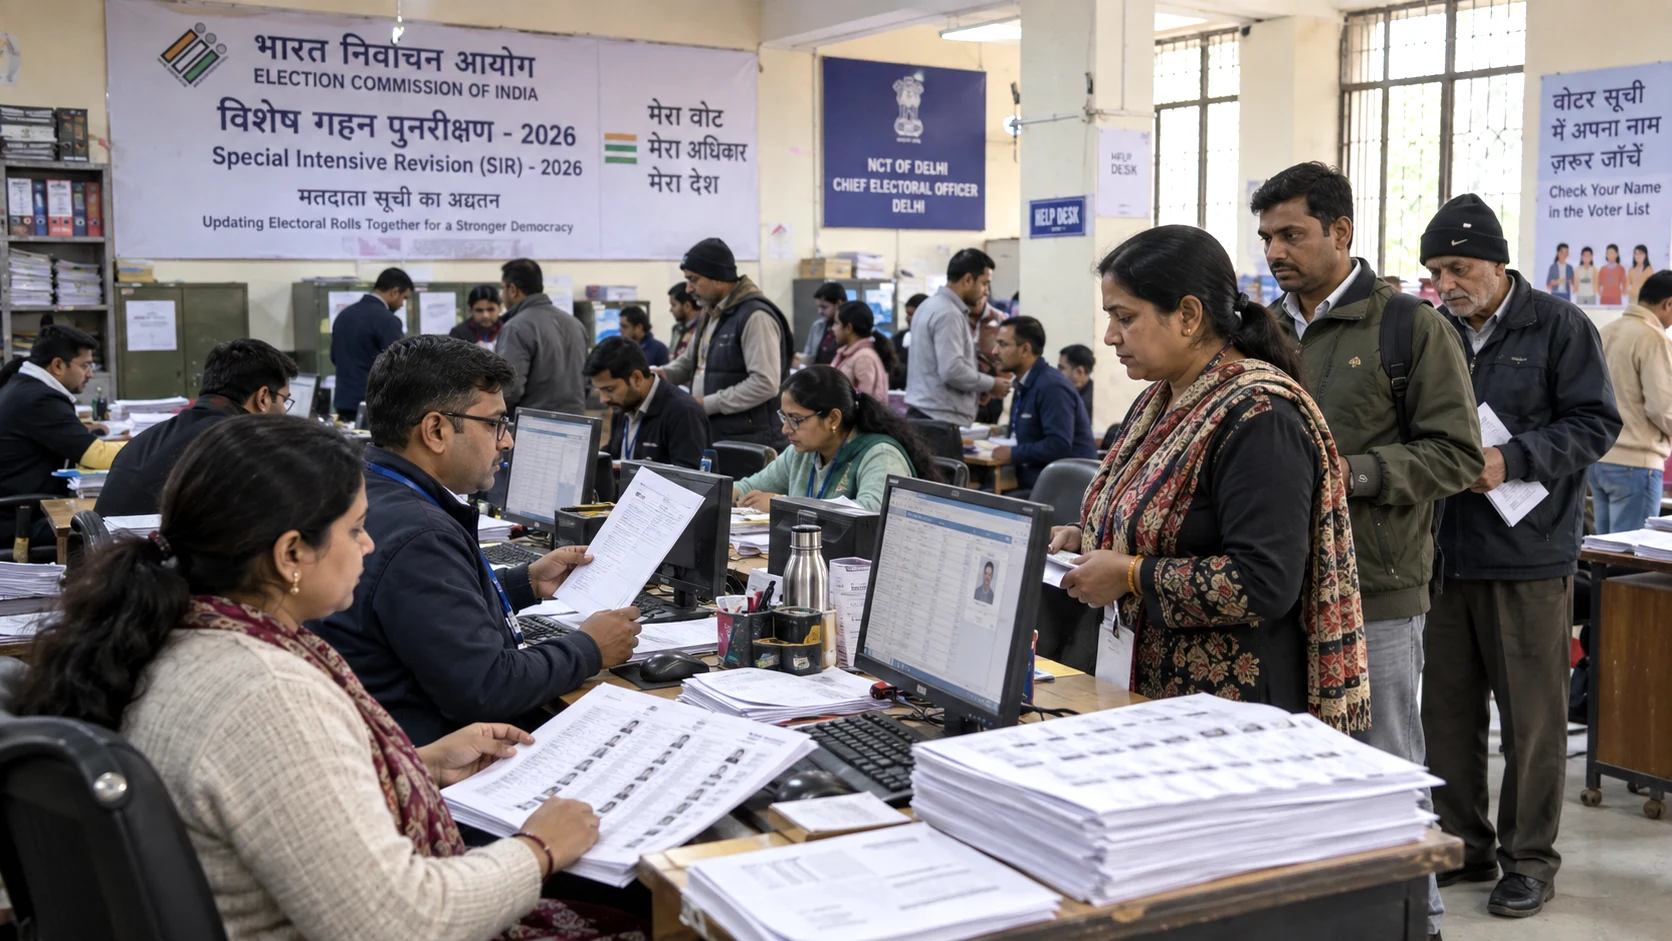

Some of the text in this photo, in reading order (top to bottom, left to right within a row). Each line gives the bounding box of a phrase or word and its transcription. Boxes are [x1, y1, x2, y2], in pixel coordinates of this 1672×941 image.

[255, 35, 329, 62] भारत
[455, 46, 535, 78] आयोग
[254, 68, 538, 101] ELECTION COMMISSION OF INDIA
[1553, 80, 1645, 112] वोटर सूची
[217, 97, 301, 134] विशेष
[312, 112, 377, 140] गहन
[387, 109, 494, 148] पुनरीक्षण
[521, 123, 576, 146] 2026
[648, 98, 724, 128] मेरा वोट
[1552, 116, 1662, 141] में अपना नाम
[648, 132, 748, 161] मेरा अधिकार
[213, 146, 288, 170] Special
[297, 149, 387, 170] Intensive
[395, 154, 473, 173] Revision
[480, 156, 522, 178] (SIR)
[541, 159, 582, 176] 2026
[868, 158, 948, 175] NCT OF DELHI
[1112, 164, 1137, 175] DESK
[648, 166, 719, 195] मेरा देश
[833, 178, 978, 197] CHIEF ELECTORAL OFFICER
[1549, 182, 1661, 198] Check Your Name
[298, 186, 500, 213] मतदाता सूची का अद्यतन
[893, 199, 925, 213] DELHI
[1549, 202, 1649, 218] in the Voter List
[203, 216, 573, 234] Updating Electoral Rolls Together for a Stronger Democracy
[1035, 206, 1079, 226] HELP DESK
